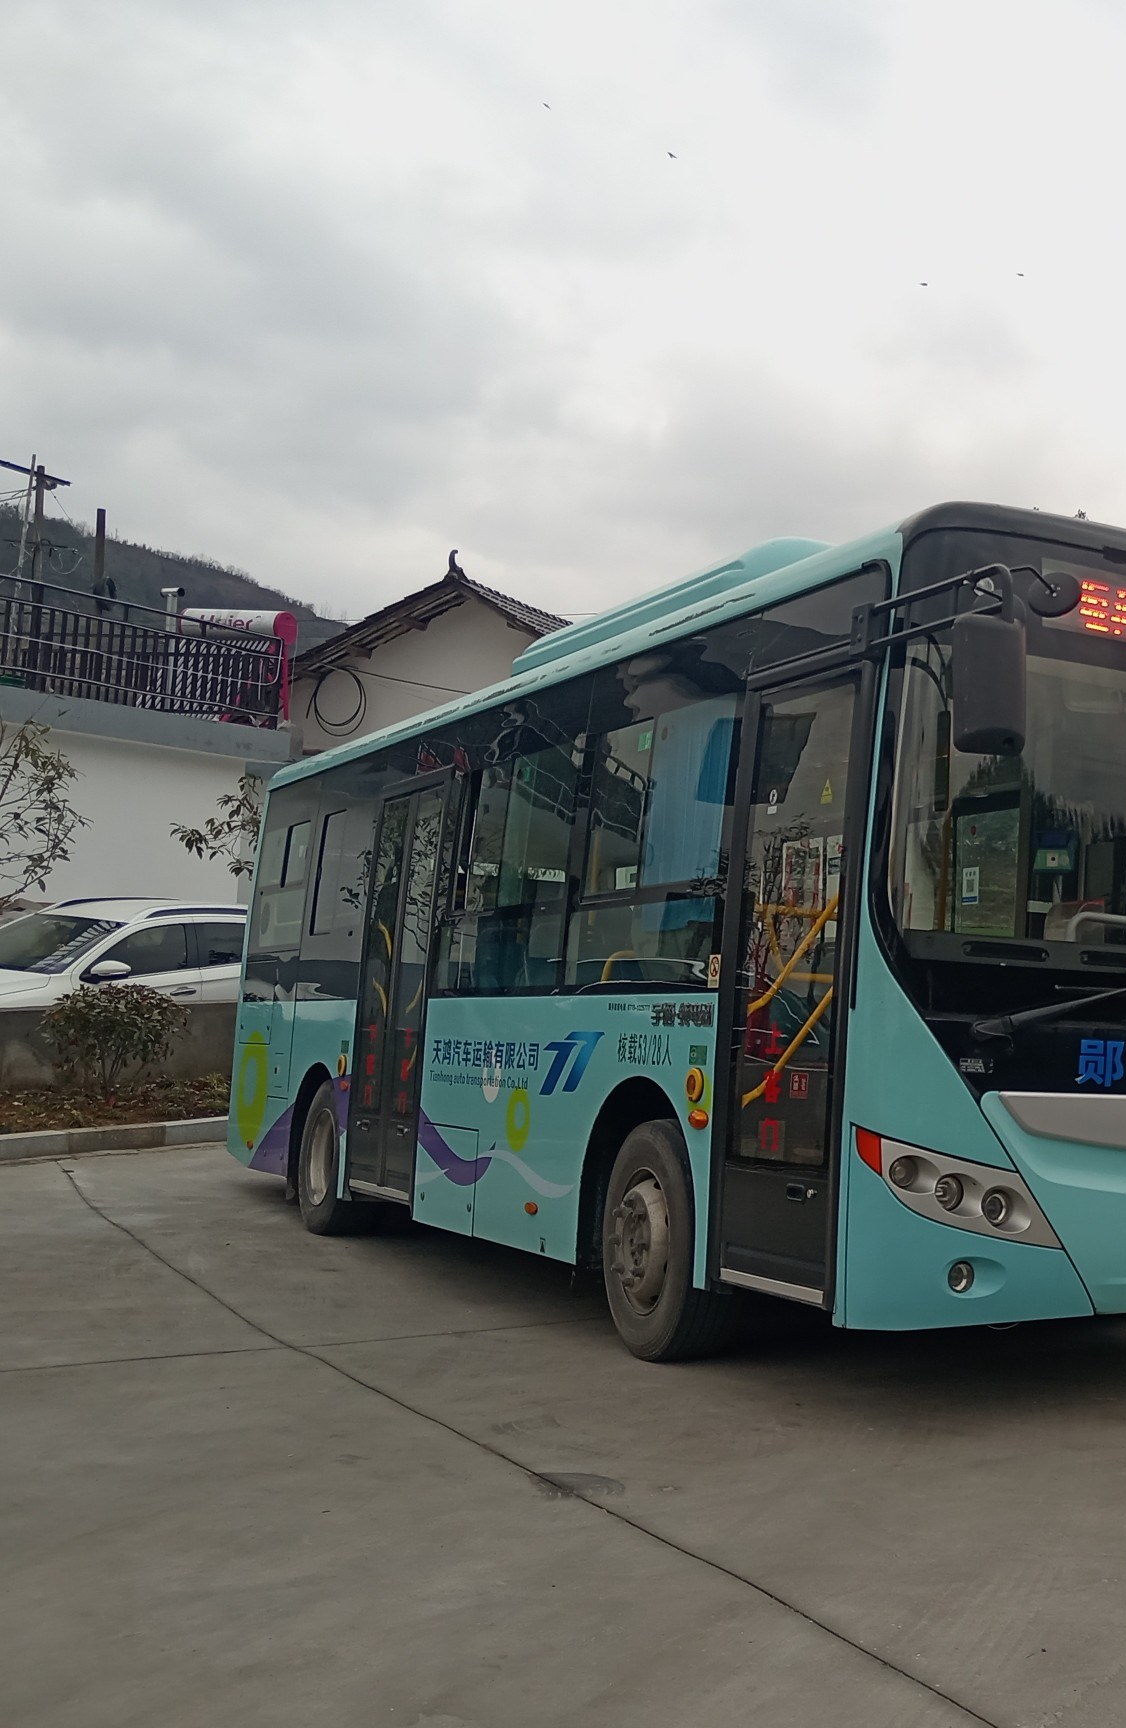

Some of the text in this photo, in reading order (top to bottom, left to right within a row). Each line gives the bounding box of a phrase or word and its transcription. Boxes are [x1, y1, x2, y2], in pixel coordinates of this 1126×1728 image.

[431, 1038, 540, 1072] 天鸿汽车运输有限公司
[617, 1033, 672, 1067] 核载53/28人
